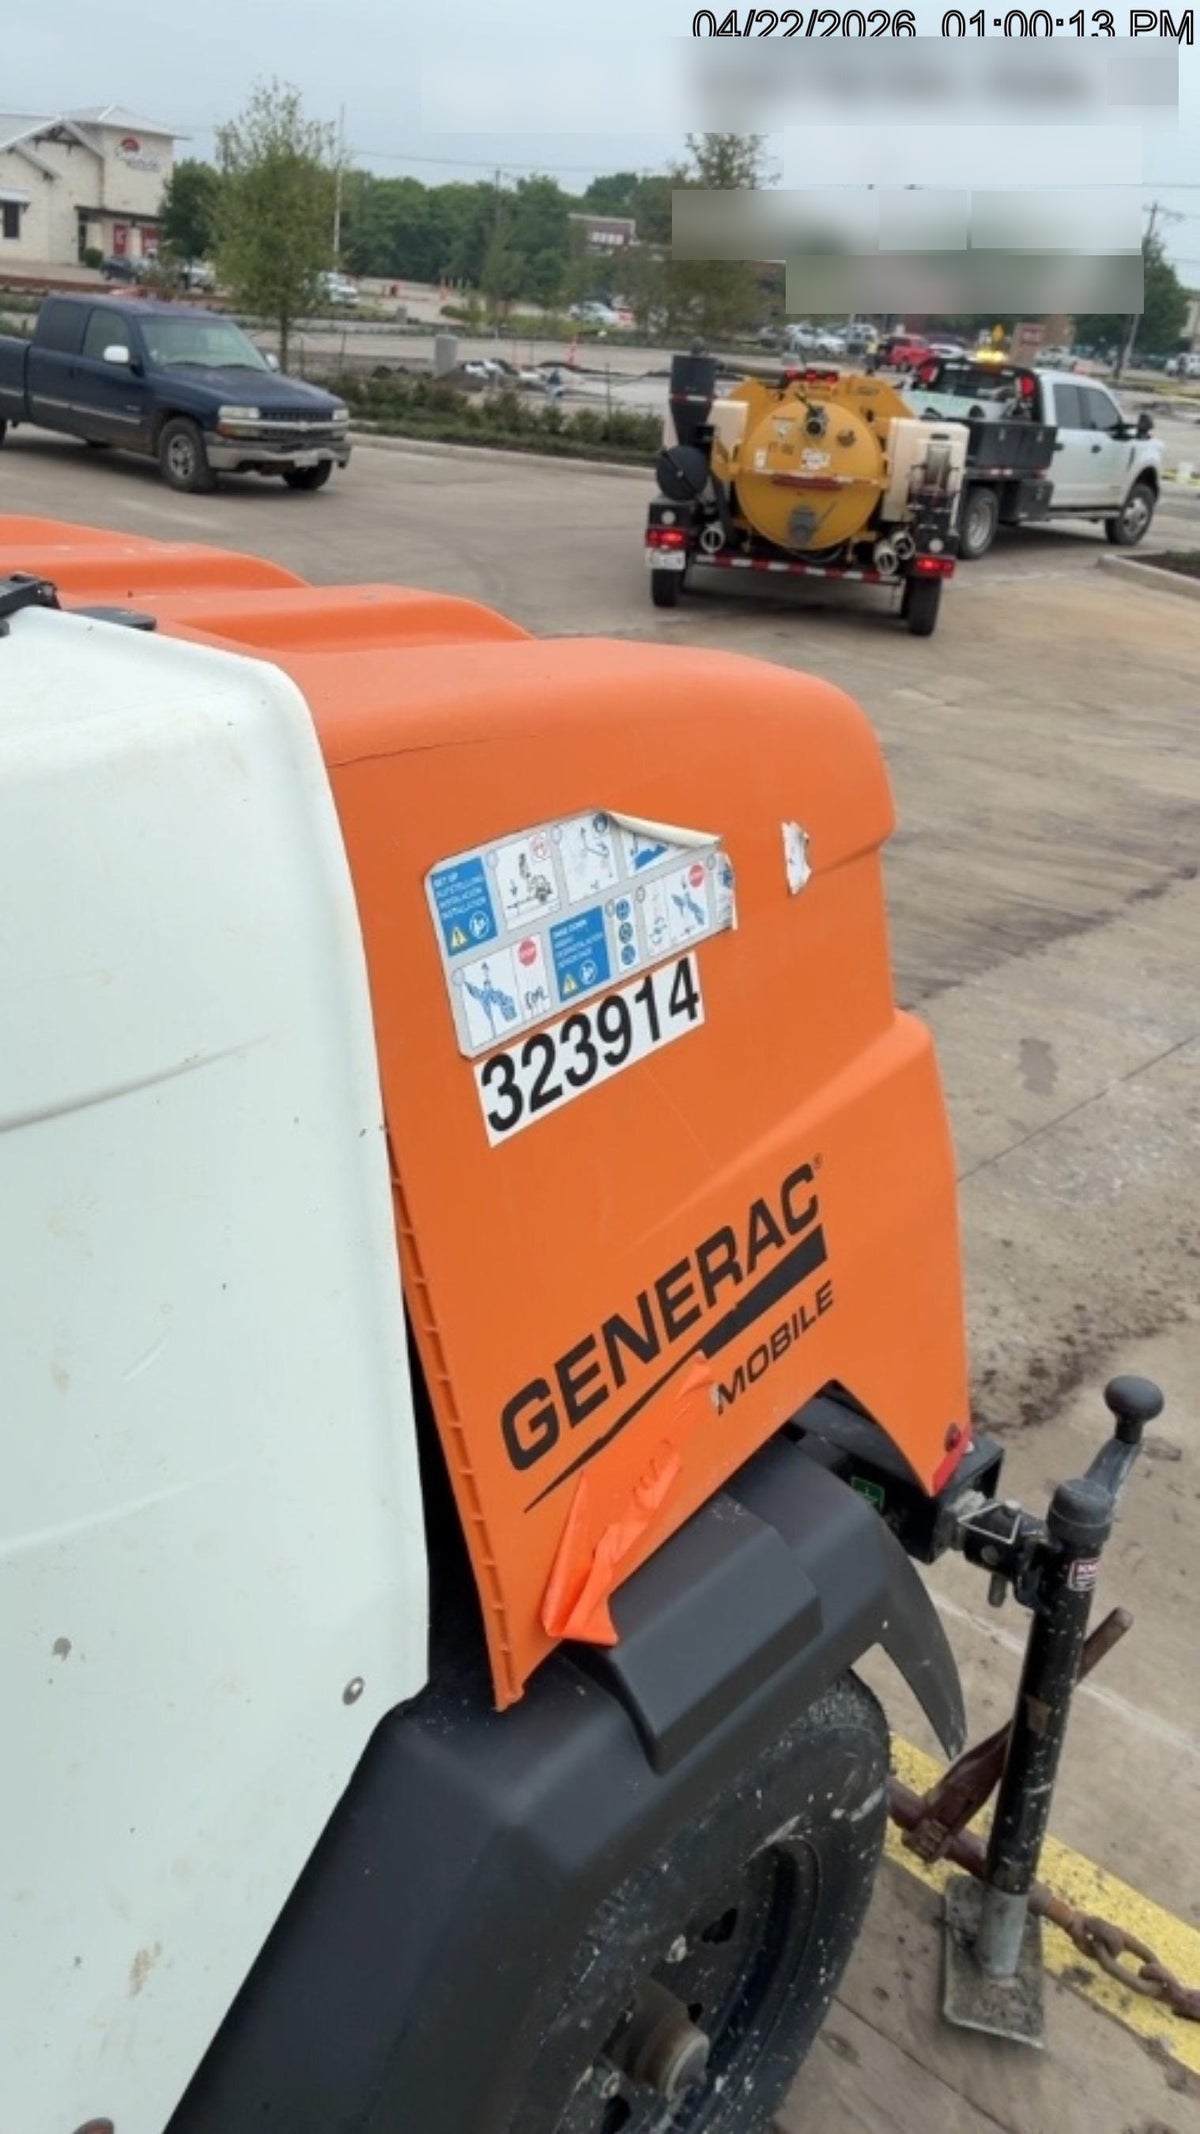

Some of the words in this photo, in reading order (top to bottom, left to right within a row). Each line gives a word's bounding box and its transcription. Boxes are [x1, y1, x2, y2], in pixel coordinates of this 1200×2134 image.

[481, 957, 700, 1132] 323914
[500, 1162, 820, 1471] GENERAC
[716, 1279, 834, 1416] MOBILE
